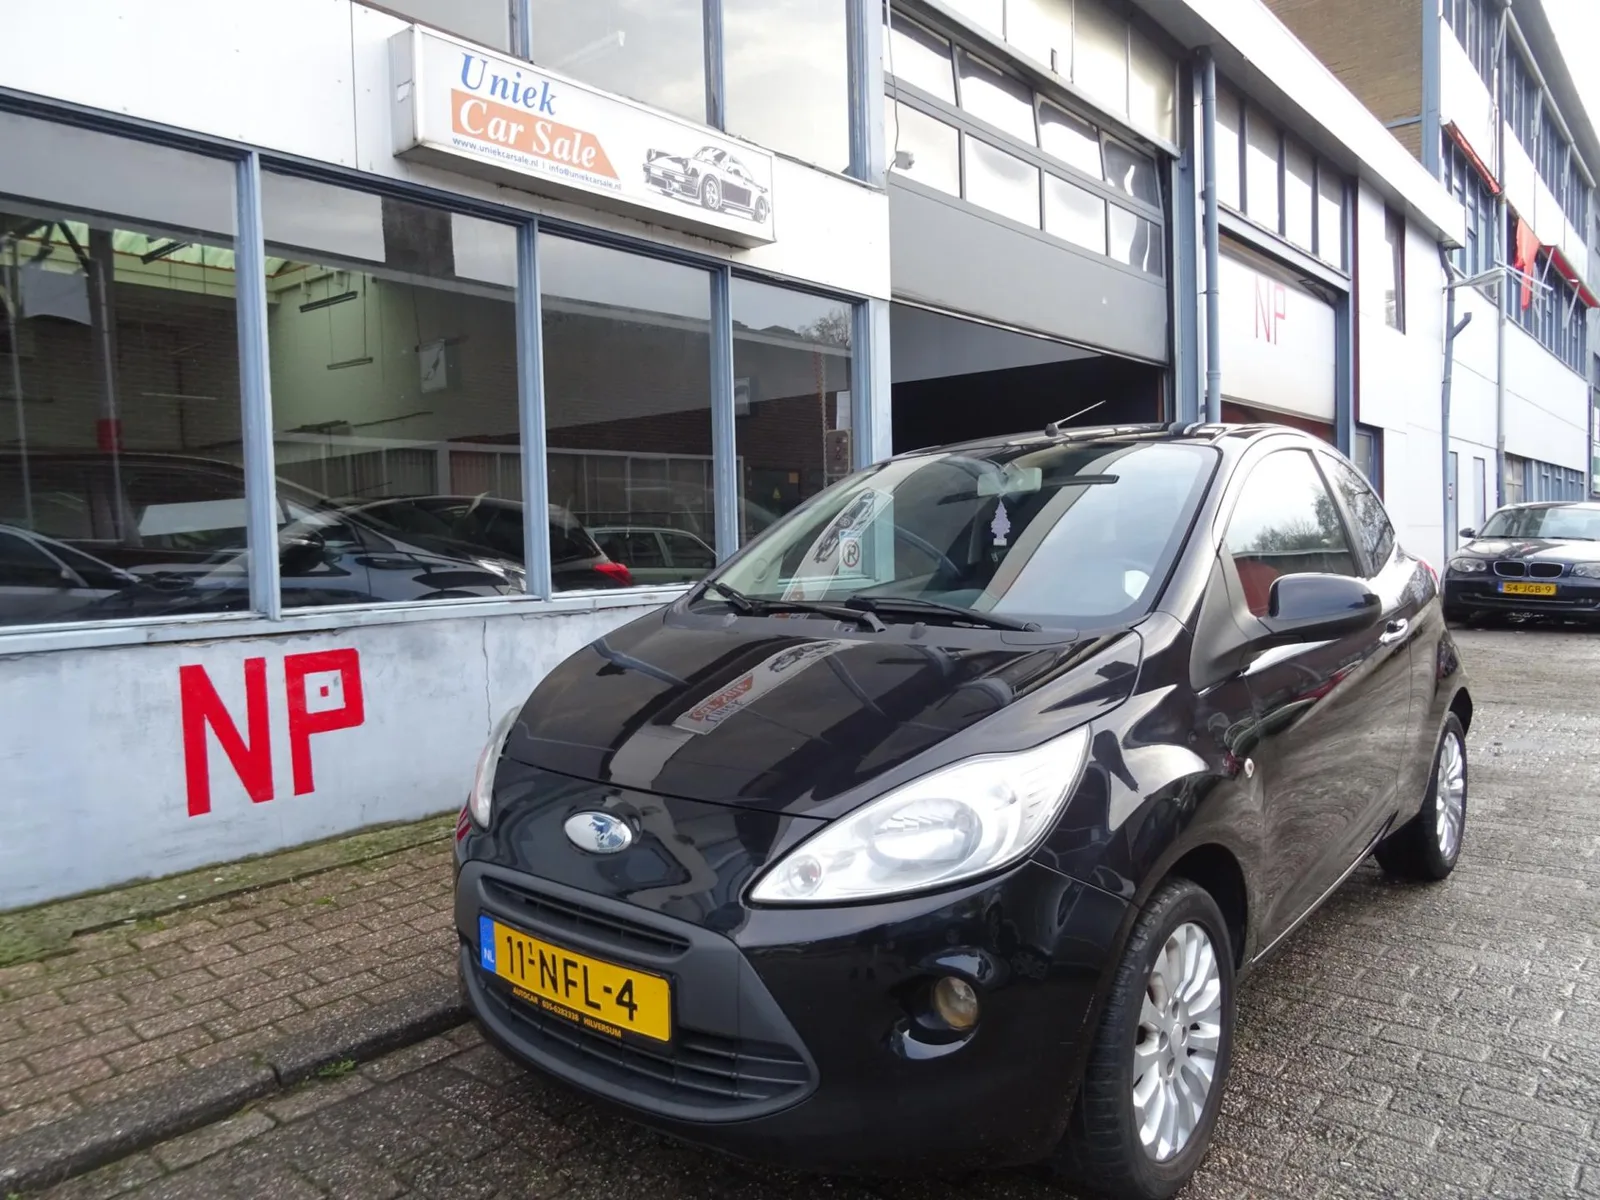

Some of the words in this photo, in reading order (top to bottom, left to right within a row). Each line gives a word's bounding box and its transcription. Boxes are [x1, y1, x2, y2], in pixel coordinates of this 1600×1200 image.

[461, 52, 557, 115] Uniek
[452, 136, 539, 168] www.uniekcarsale.nl
[549, 164, 622, 191] info@uniekcarsale.nl
[460, 98, 524, 143] Car
[532, 120, 597, 170] Sale
[1255, 275, 1286, 345] NP
[179, 647, 365, 818] NP
[483, 947, 495, 963] NL
[512, 987, 539, 1004] AUTOCAR
[583, 1017, 622, 1038] HILVERSUM
